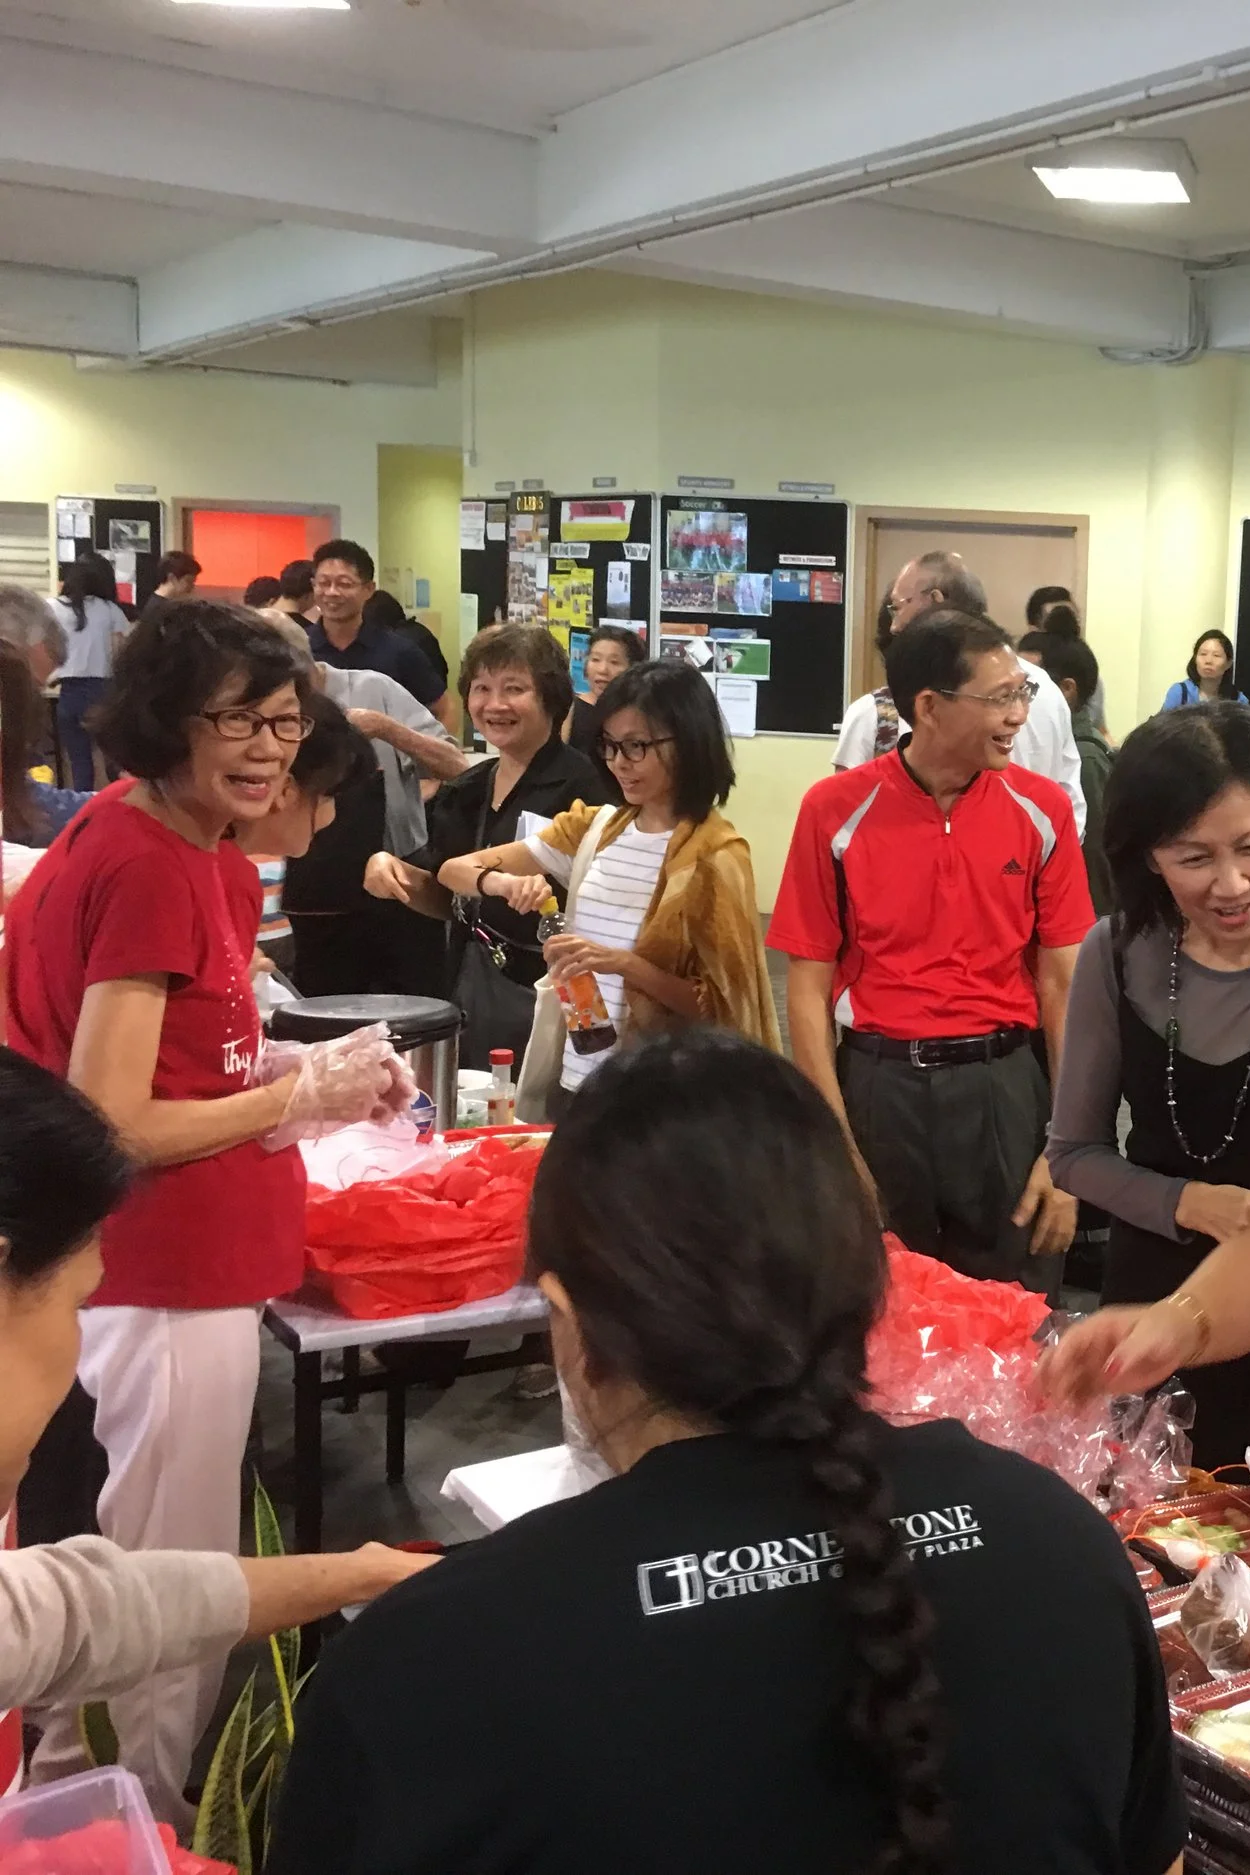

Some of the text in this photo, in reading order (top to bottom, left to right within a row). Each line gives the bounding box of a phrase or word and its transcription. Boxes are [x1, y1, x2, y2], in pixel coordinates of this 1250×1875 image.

[702, 1504, 980, 1578] CORNEONE
[706, 1564, 820, 1601] CHURCH
[924, 1535, 985, 1558] PLAZA
